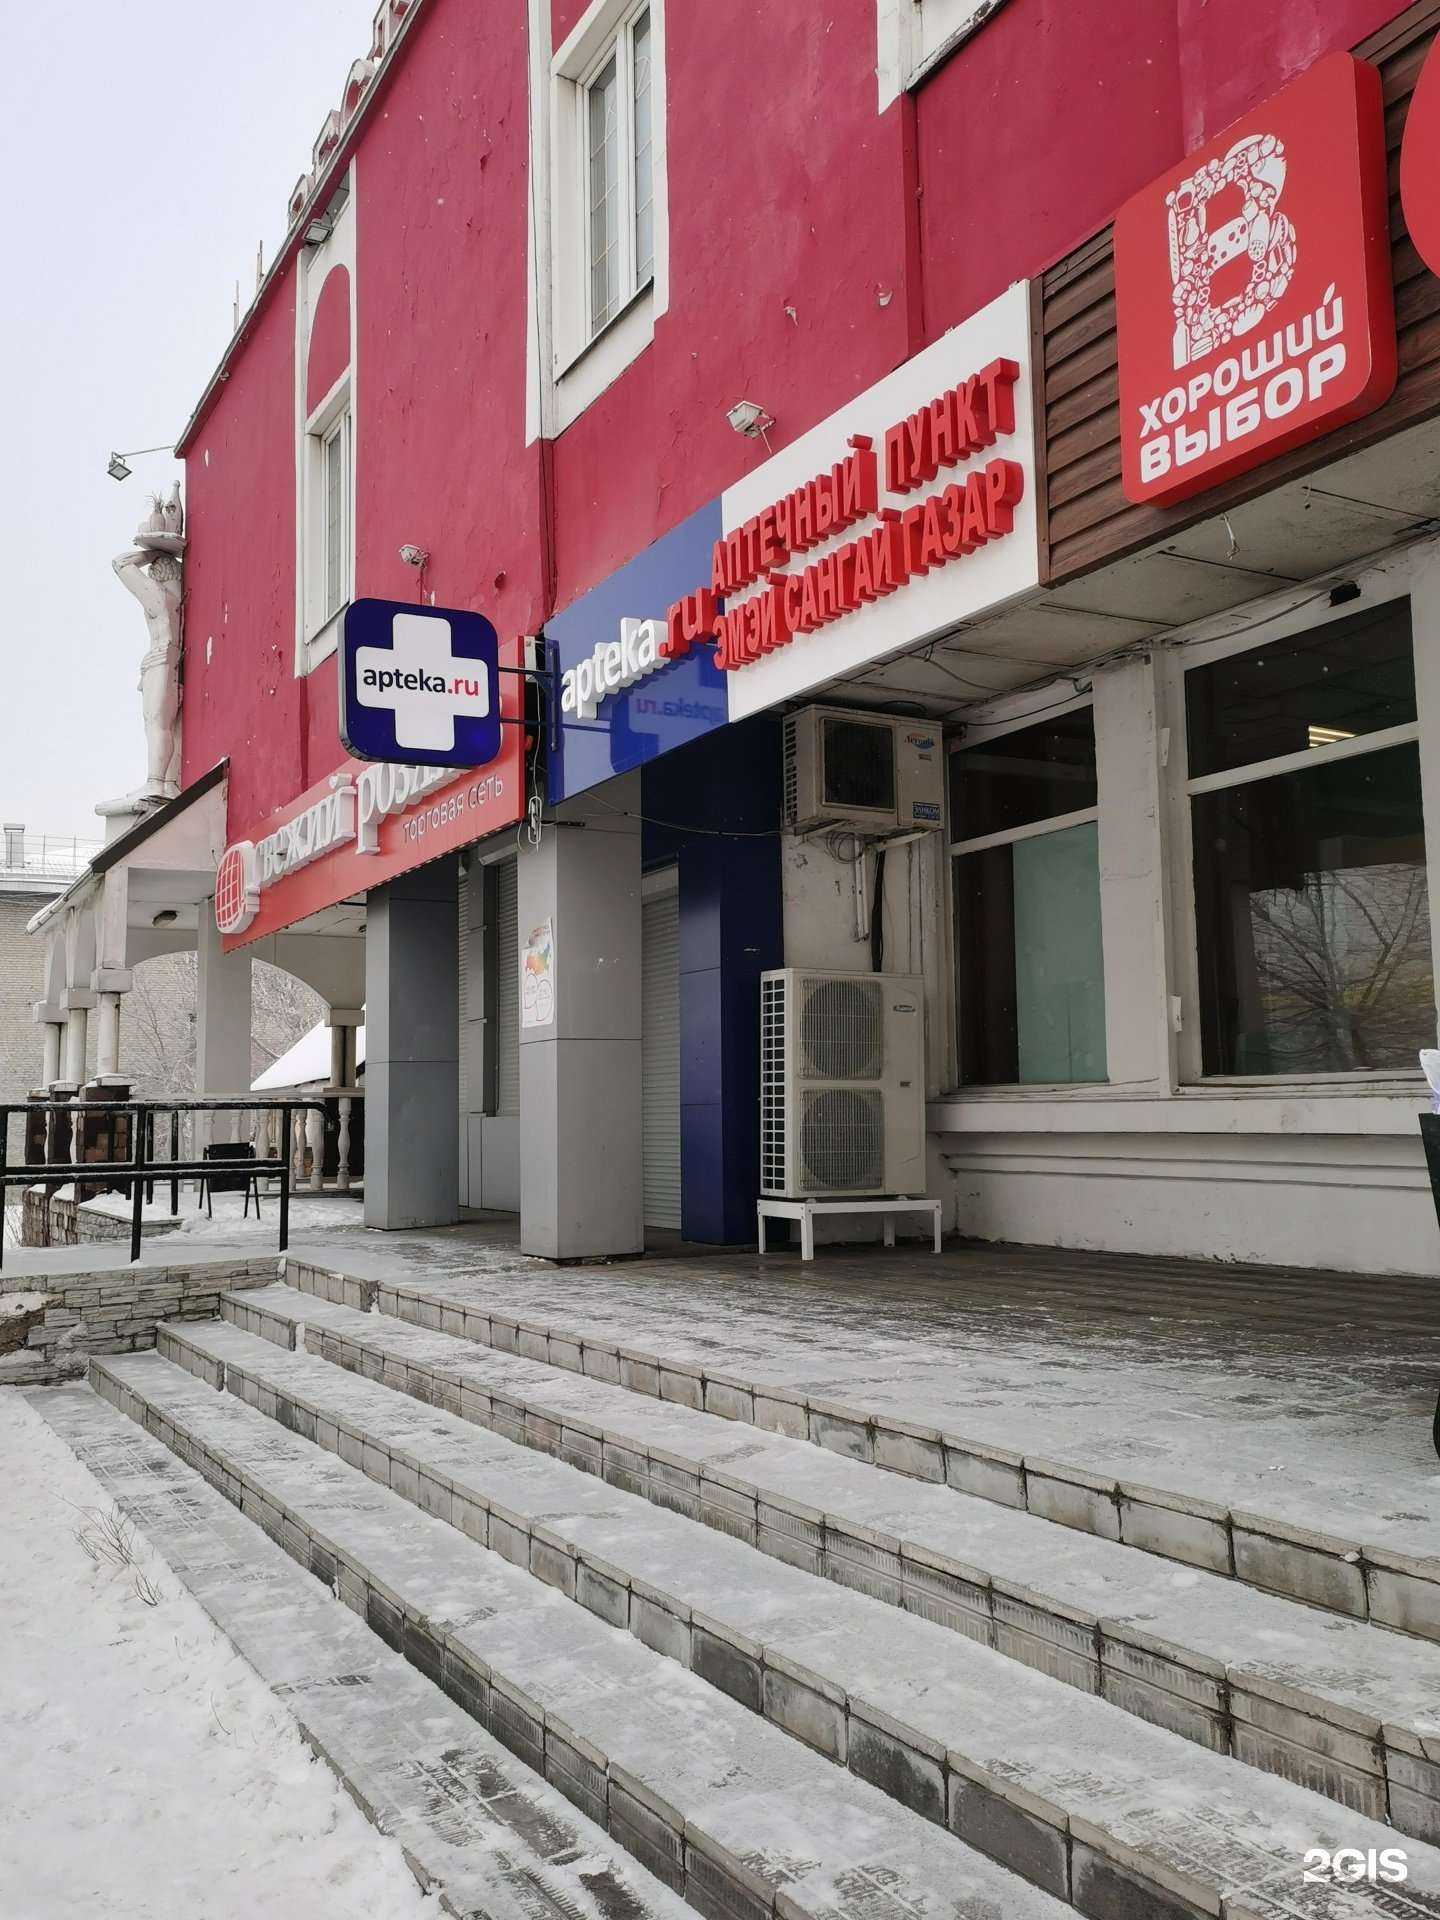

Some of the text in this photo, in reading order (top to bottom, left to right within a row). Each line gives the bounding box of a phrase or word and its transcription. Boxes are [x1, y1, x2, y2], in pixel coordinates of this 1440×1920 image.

[1138, 283, 1344, 438] ХОРОШИЙ
[1140, 343, 1346, 484] ВЫБОР
[711, 358, 1019, 598] АПТЕЧНЫЙ ПУНКТ
[712, 458, 1024, 671] ЭМЭЙ САНГАЙ ГАЗАР
[363, 668, 480, 696] apteka.ru
[561, 587, 715, 720] apteka.ru
[402, 774, 503, 843] торговая сеть
